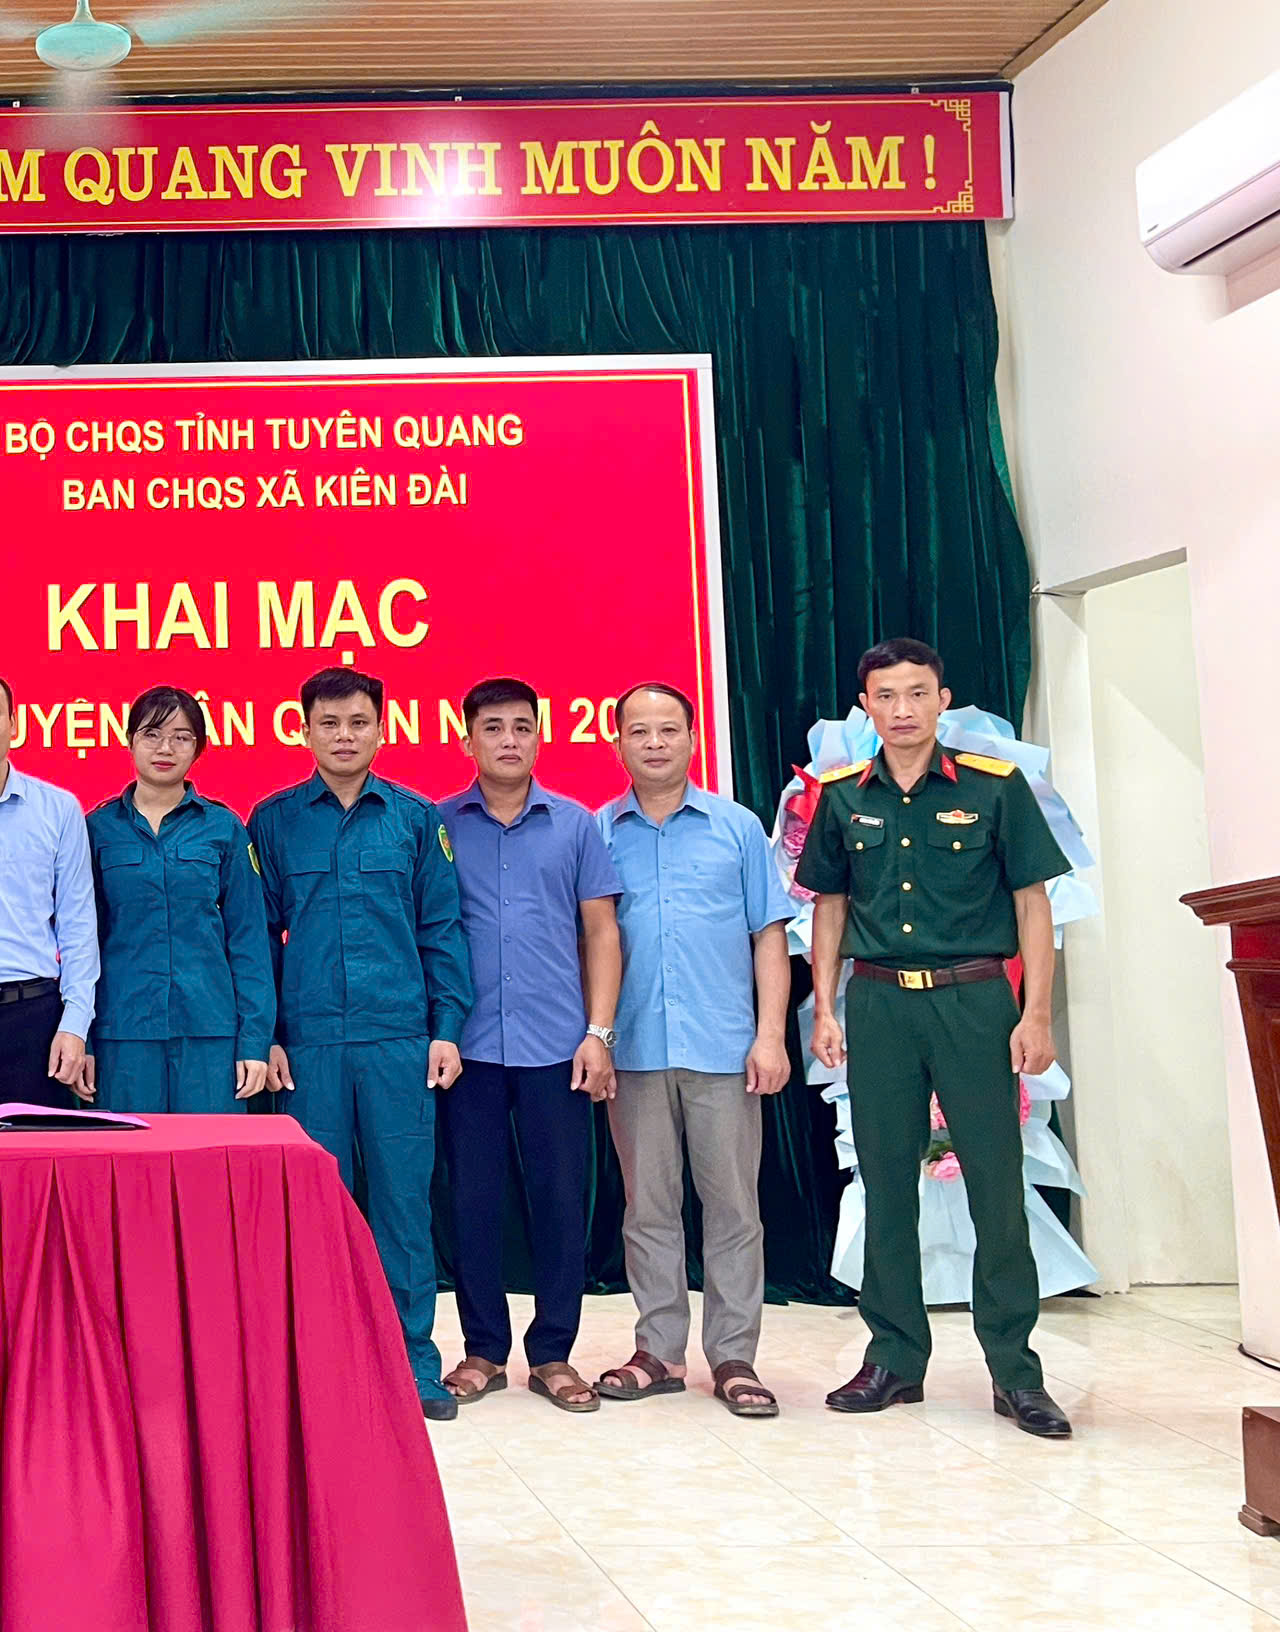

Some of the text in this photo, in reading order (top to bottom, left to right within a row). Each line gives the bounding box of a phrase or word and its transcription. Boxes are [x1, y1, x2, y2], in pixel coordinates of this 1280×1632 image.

[64, 143, 306, 206] QUANG
[326, 141, 501, 196] VINH
[521, 122, 725, 195] MUÔN
[747, 121, 905, 191] NĂM
[6, 408, 523, 460] BỘ CHQS TỈNH TUYÊN QUANG
[63, 464, 467, 511] BAN CHQS XÃ KIÊN ĐÀI
[47, 578, 429, 665] KHAI MẠC
[10, 699, 131, 759] UYỆN
[195, 690, 255, 746] ÂN
[273, 699, 420, 747] QN
[569, 697, 619, 743] 20
